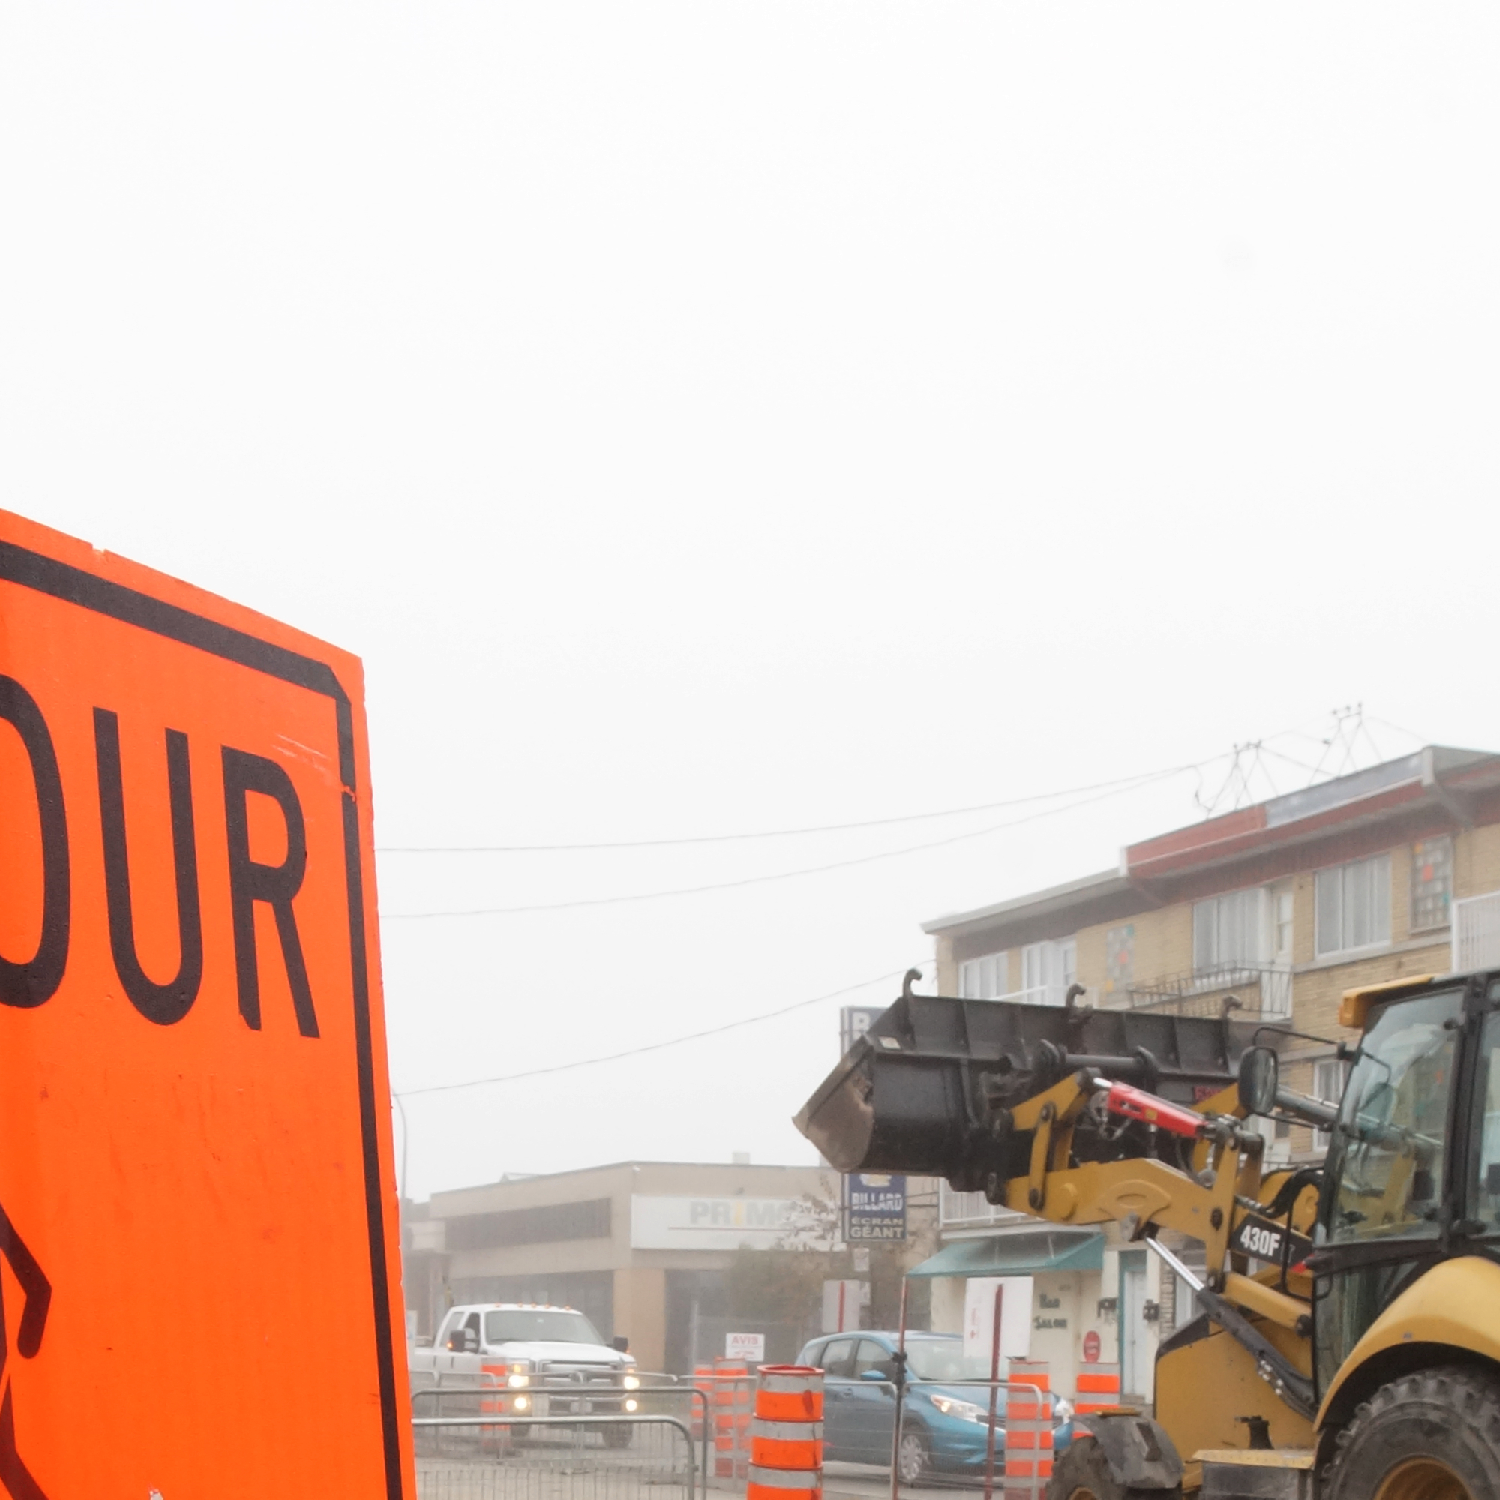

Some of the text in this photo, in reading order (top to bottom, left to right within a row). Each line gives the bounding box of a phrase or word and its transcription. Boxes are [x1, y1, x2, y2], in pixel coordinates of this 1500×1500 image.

[851, 1191, 904, 1211] BILLARD
[851, 1215, 904, 1226] ÉCRAN
[850, 1225, 904, 1238] GÉANT
[1240, 1224, 1281, 1257] 430F
[731, 1334, 759, 1346] AVIS
